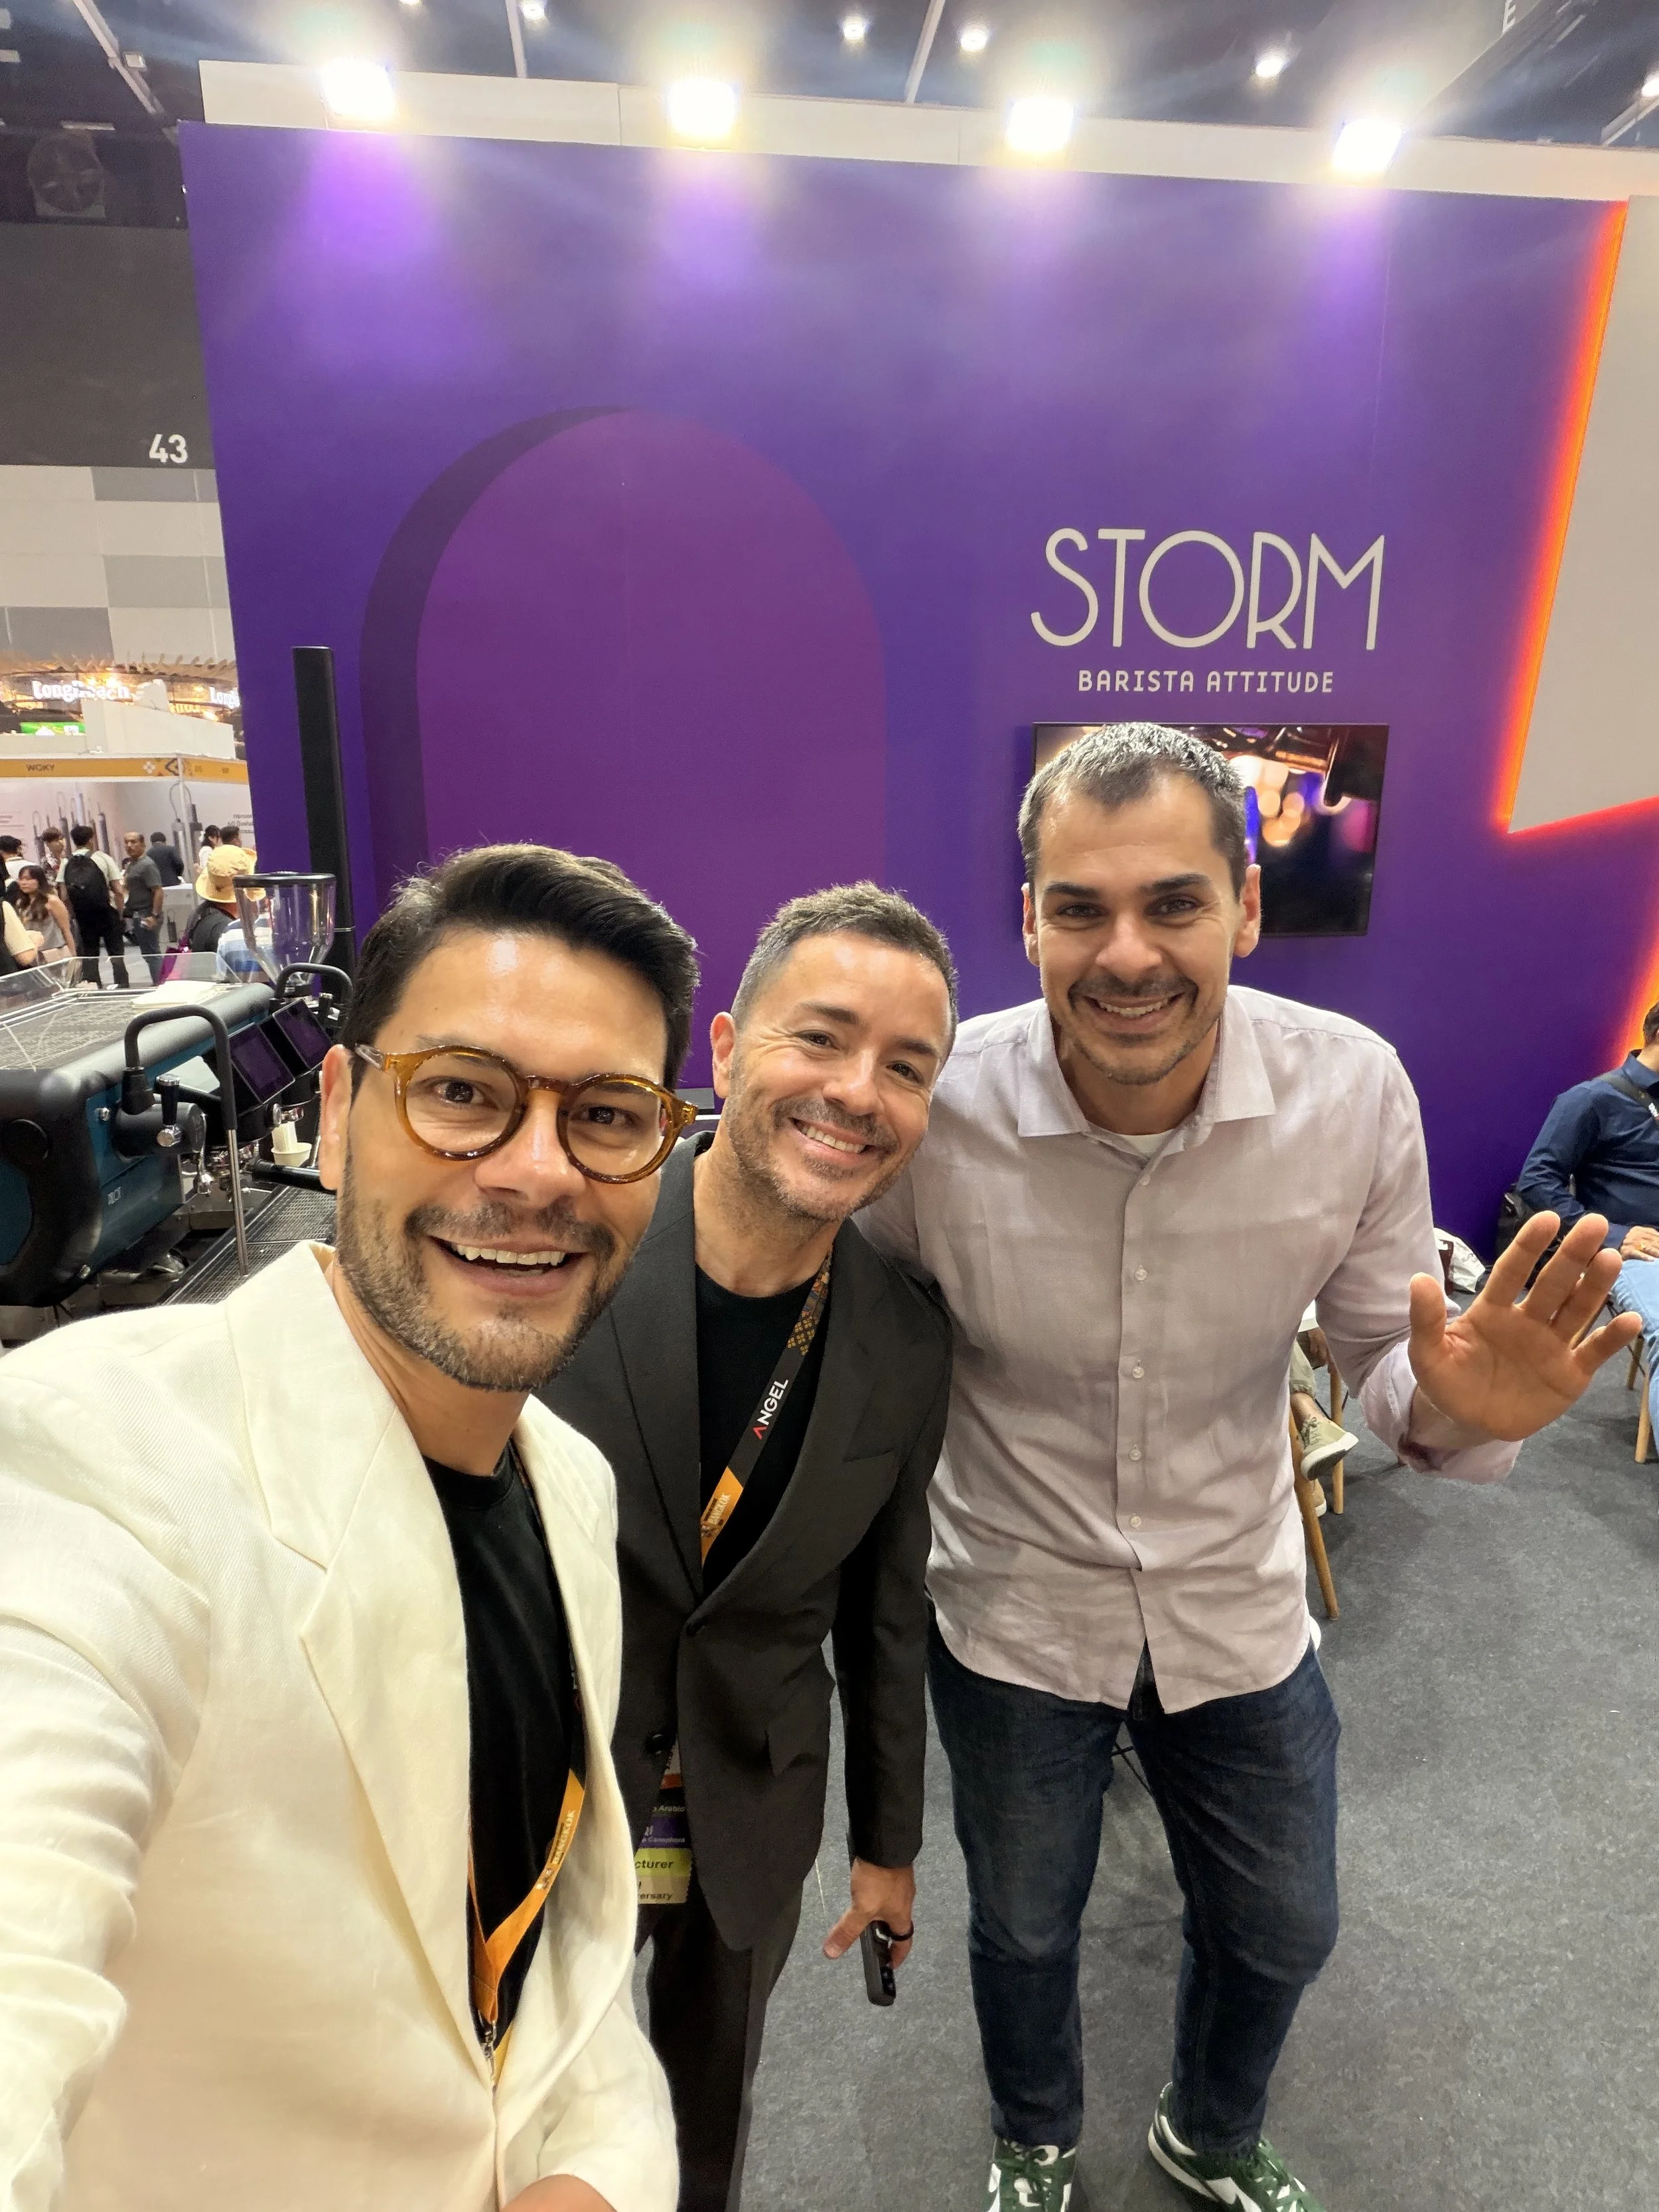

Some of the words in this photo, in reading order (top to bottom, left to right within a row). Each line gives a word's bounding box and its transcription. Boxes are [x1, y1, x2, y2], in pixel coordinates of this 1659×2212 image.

[149, 433, 188, 463] 43
[1031, 528, 1385, 650] STORM
[1078, 670, 1194, 692] BARISTA
[1206, 670, 1333, 694] ATTITUDE
[753, 1379, 789, 1440] ANGEL
[707, 1492, 731, 1525] BANGKOK
[552, 1810, 575, 1864] BANGKOK
